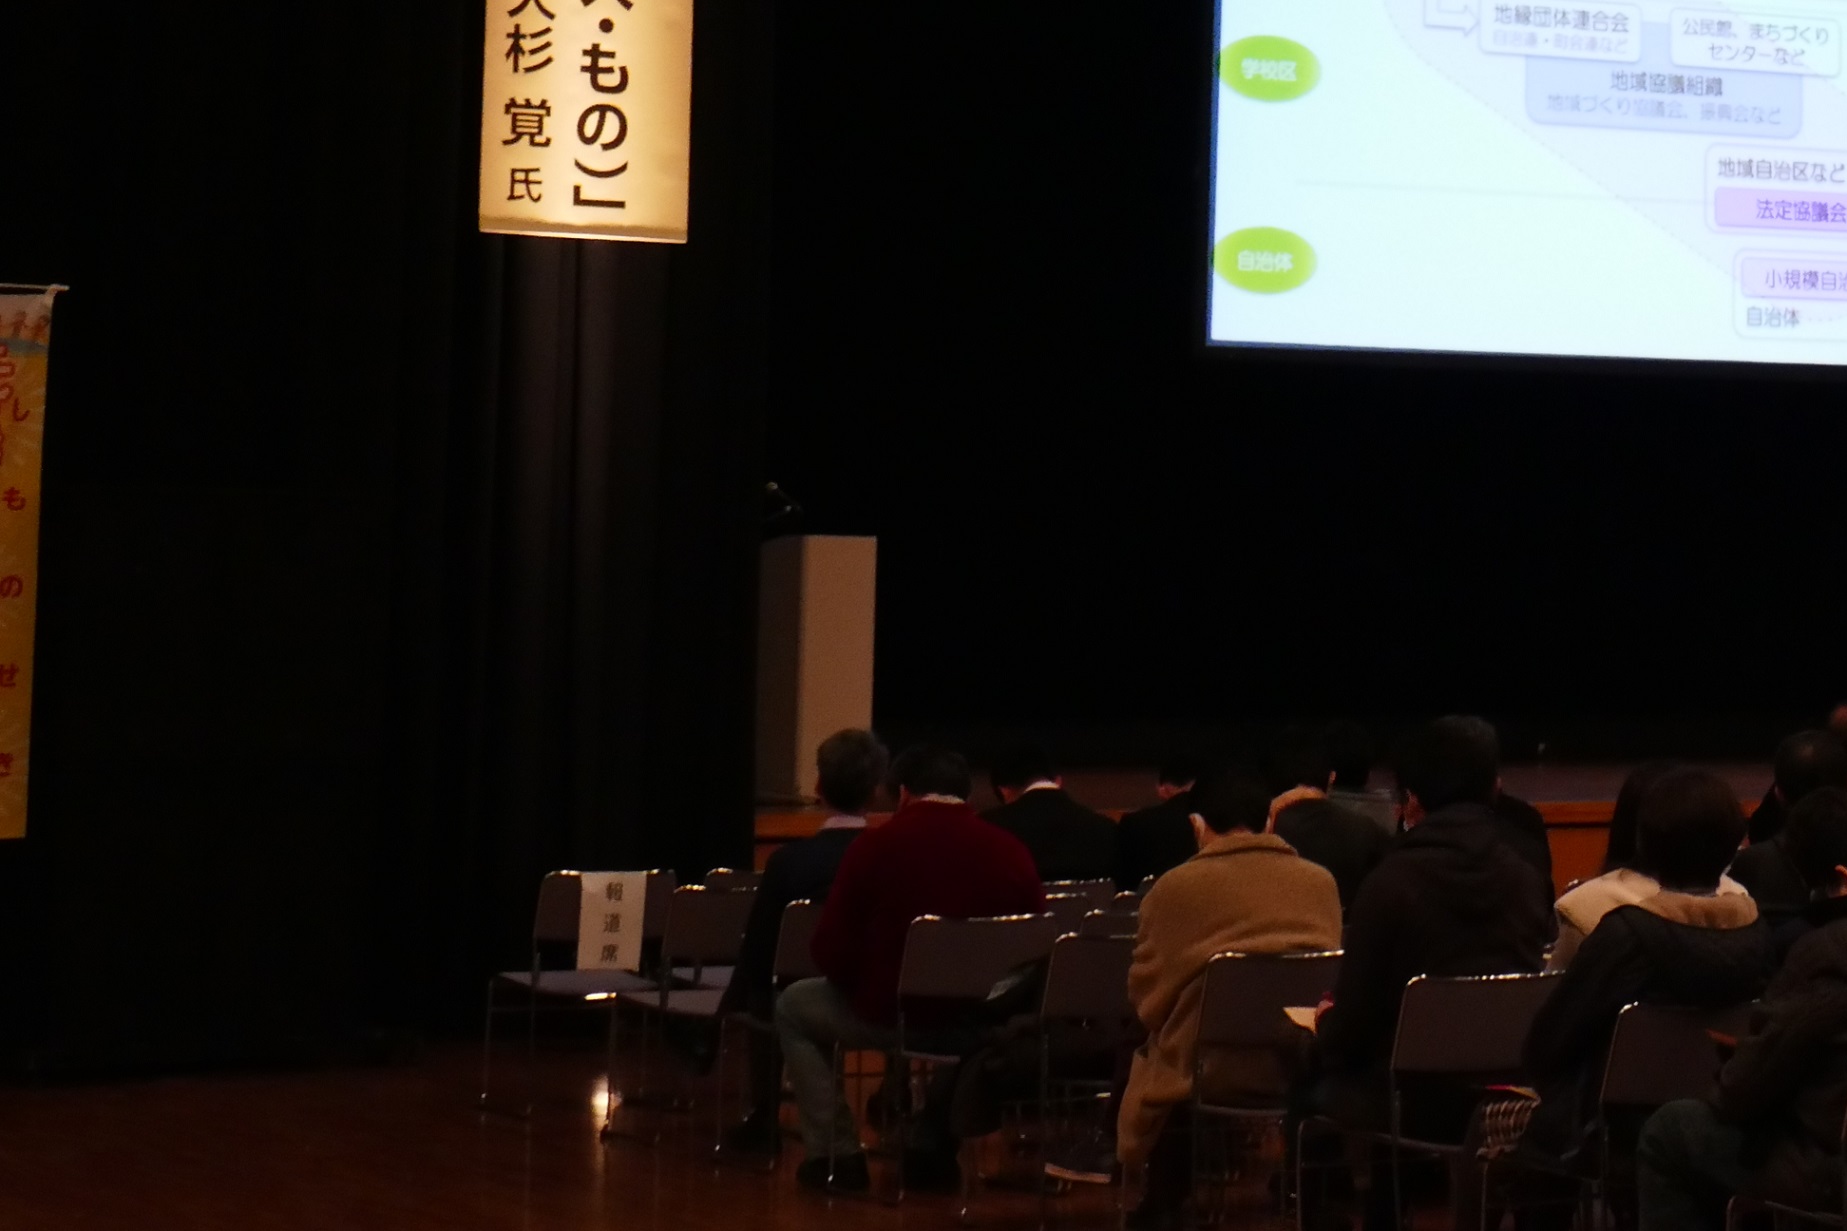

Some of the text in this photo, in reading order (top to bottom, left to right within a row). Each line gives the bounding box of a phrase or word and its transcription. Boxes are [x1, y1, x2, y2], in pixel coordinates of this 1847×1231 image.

[1708, 43, 1807, 68] センターなど
[501, 96, 552, 148] 覚
[1718, 156, 1846, 184] 地域自治区など
[506, 168, 542, 203] 氏
[1755, 198, 1847, 224] 法定協議会
[1746, 305, 1801, 329] 自治体
